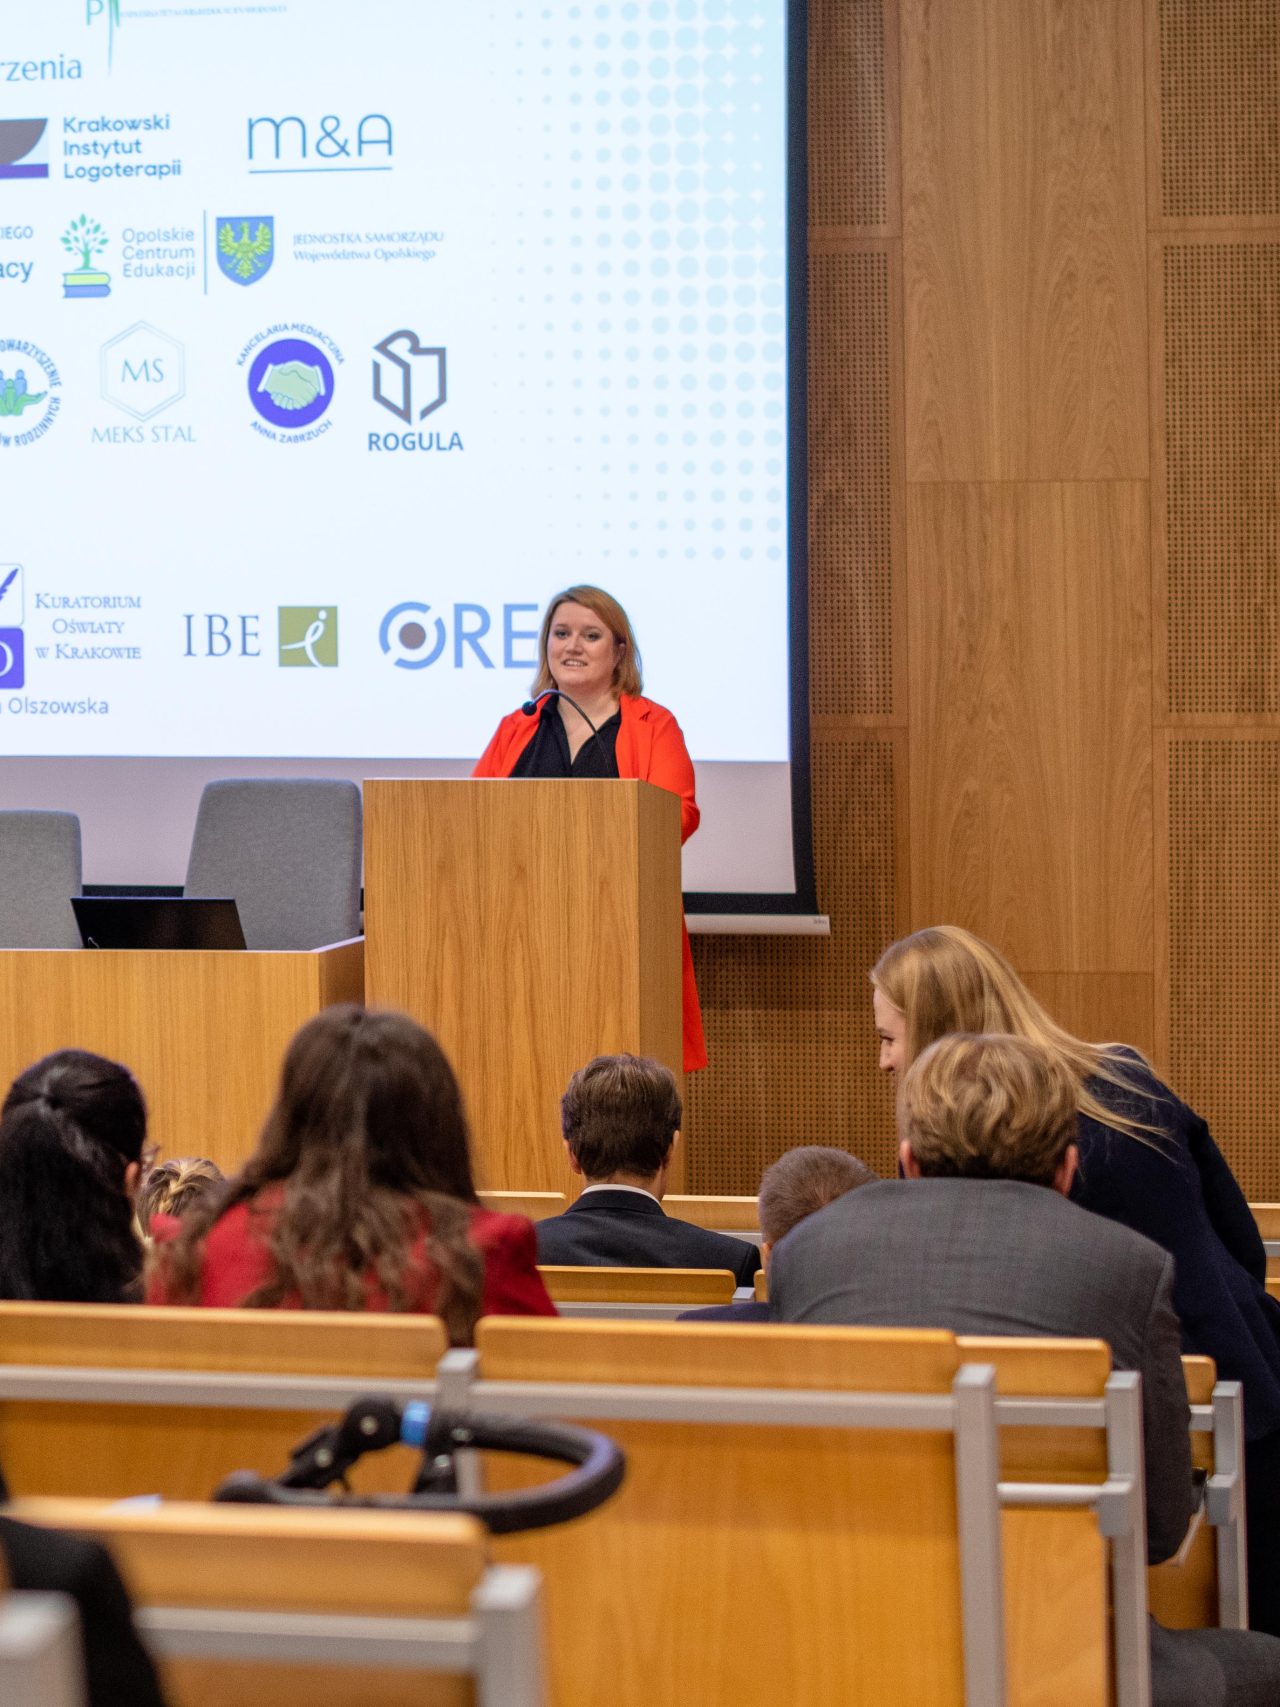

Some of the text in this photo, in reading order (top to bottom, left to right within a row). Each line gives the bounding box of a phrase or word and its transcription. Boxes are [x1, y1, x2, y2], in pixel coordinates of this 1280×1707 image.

[62, 113, 171, 134] Krakowski
[63, 138, 143, 156] Instytut
[63, 159, 182, 182] Logoterapii
[121, 227, 195, 243] Opolskie
[121, 244, 196, 260] Centrum
[292, 247, 437, 264] Województwa Opolskiego
[121, 262, 196, 279] Edukacji
[236, 322, 345, 366] KANCELARIA MEDIACYJNA
[121, 357, 165, 384] MS
[15, 396, 61, 447] RODZINNYCH
[250, 419, 332, 444] ANNA ZABRZUCH
[90, 423, 198, 444] MEKS STAL
[367, 431, 465, 452] ROGULA
[183, 613, 261, 657] IBE
[7, 696, 110, 716] Olszowska
